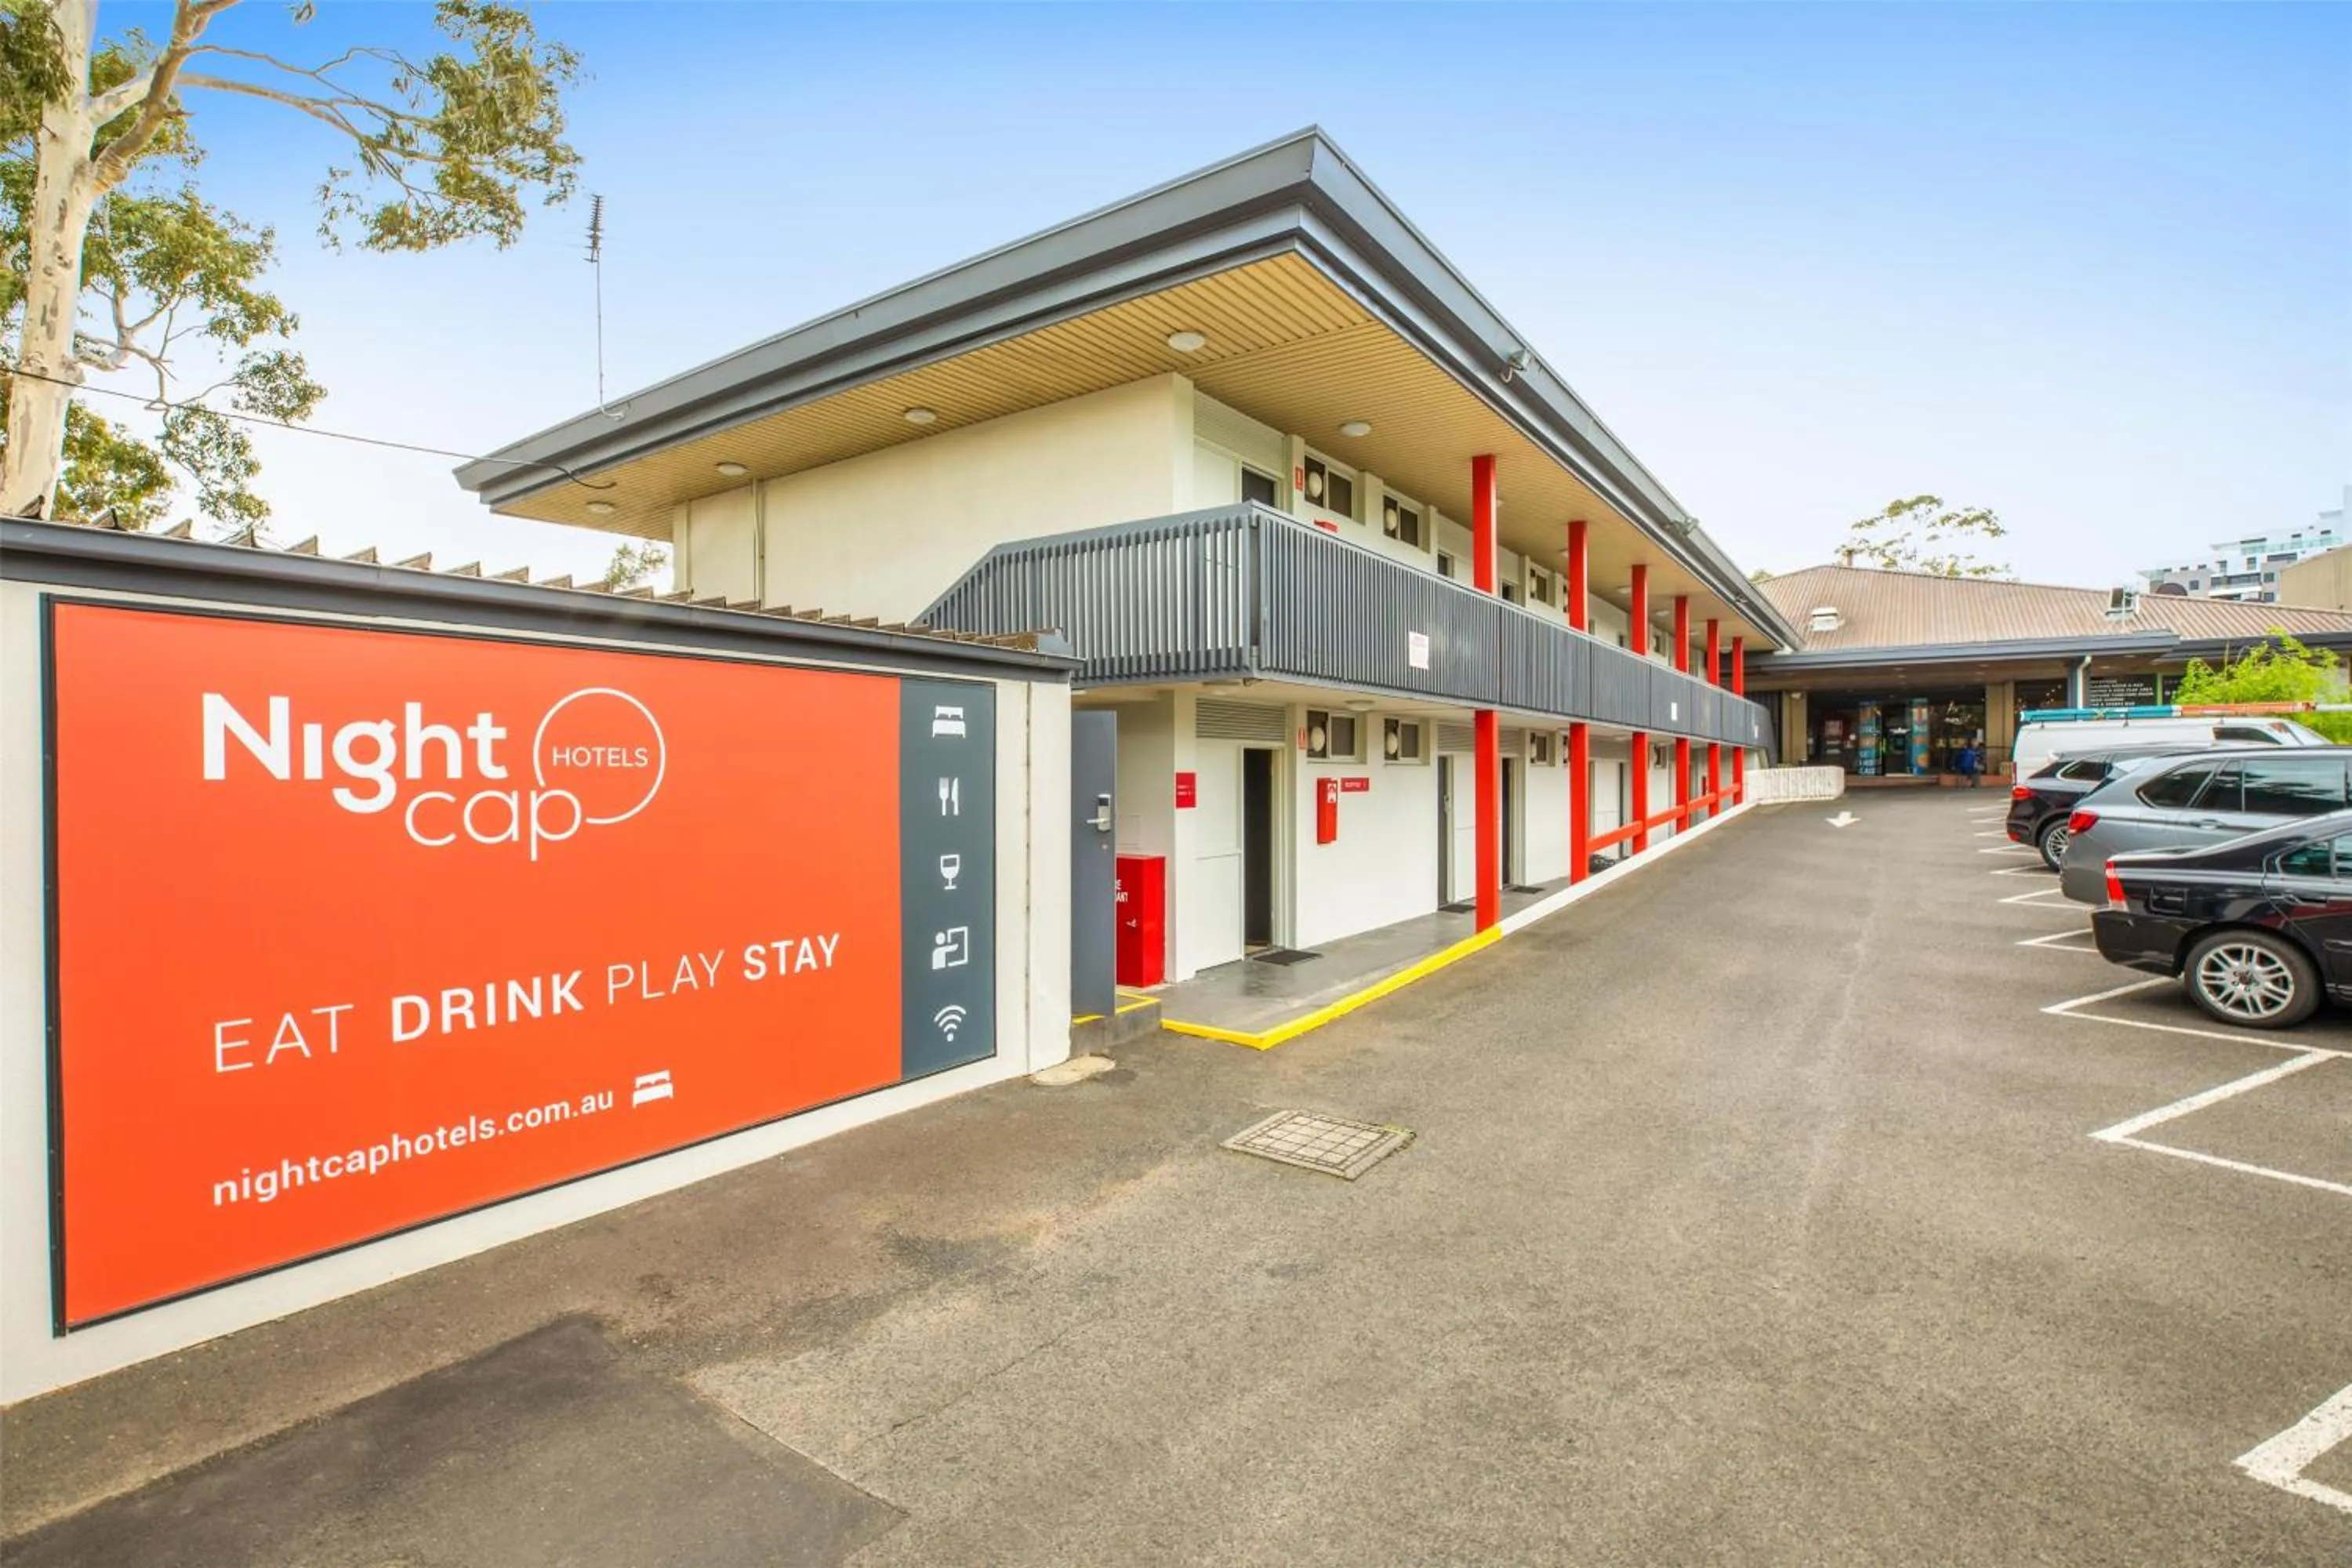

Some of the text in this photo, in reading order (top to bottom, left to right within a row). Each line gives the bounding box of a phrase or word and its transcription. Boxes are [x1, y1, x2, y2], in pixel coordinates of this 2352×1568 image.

[202, 692, 509, 814] Night
[552, 746, 648, 768] HOTELS
[405, 789, 582, 862] cap
[213, 933, 840, 1073] EAT DRINK PLAY STAY
[213, 1091, 614, 1206] nightcaphotels.com.au
